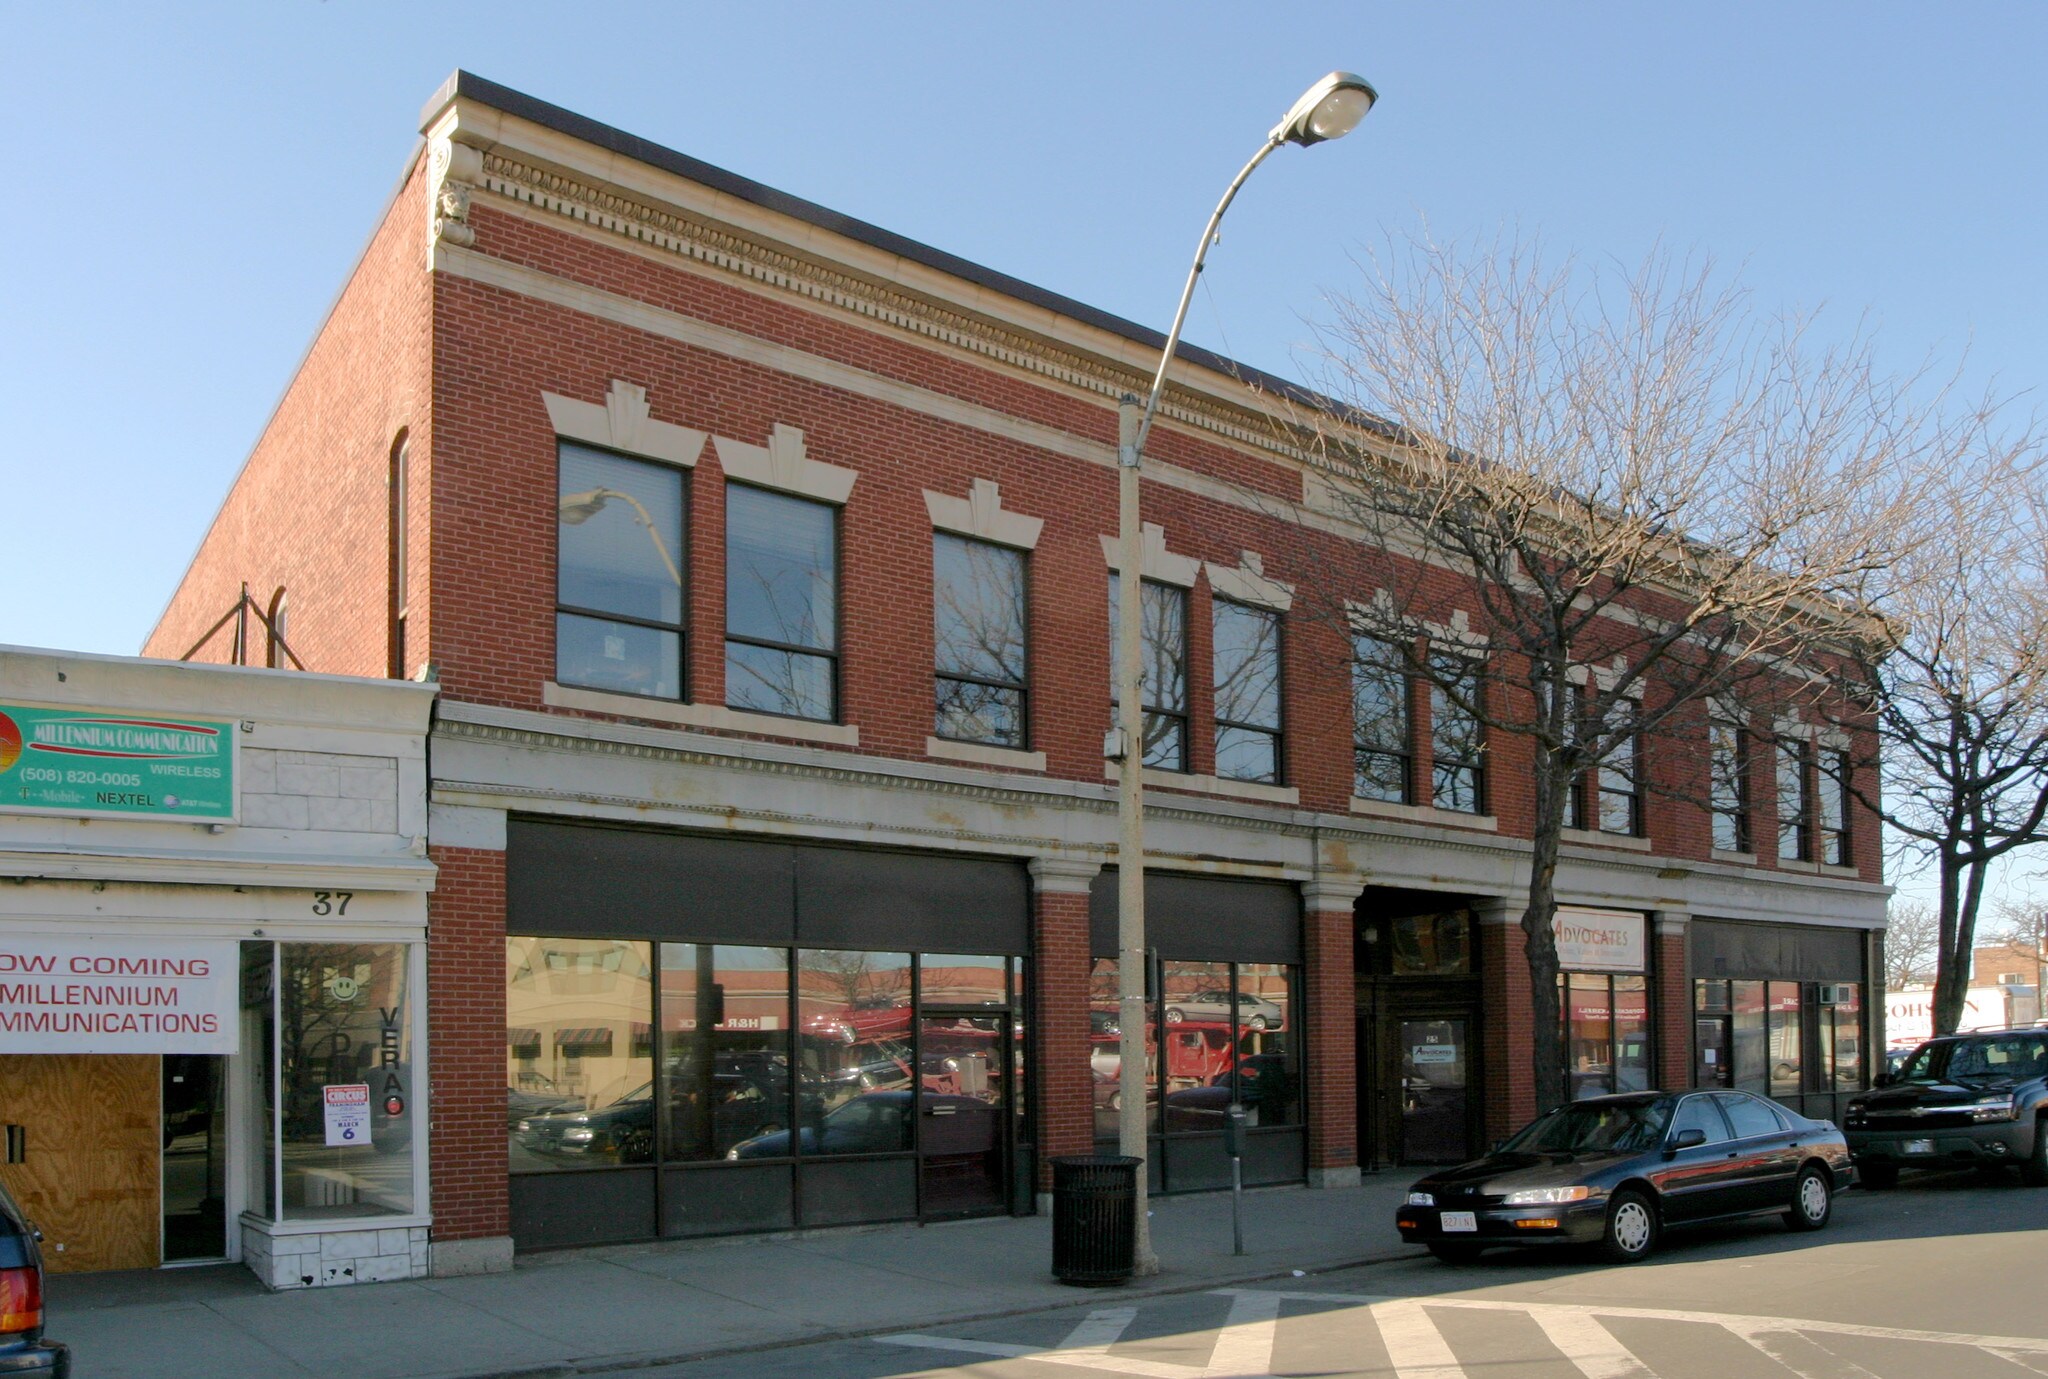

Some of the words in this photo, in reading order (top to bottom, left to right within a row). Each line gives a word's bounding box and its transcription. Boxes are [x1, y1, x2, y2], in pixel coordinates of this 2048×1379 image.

[34, 723, 116, 749] MILLENNIUM
[118, 729, 218, 754] COMMUNICATION
[20, 767, 62, 784] (508)
[67, 770, 141, 787] 820-0005
[150, 764, 221, 778] WIRELESS
[96, 791, 155, 806] NEXTEL
[312, 891, 353, 915] 37
[1554, 919, 1628, 946] ADVOCATES
[69, 956, 210, 976] COMING
[0, 984, 178, 1006] MILLENNIUM
[327, 1090, 366, 1101] CIRCUS
[342, 1127, 355, 1140] 6
